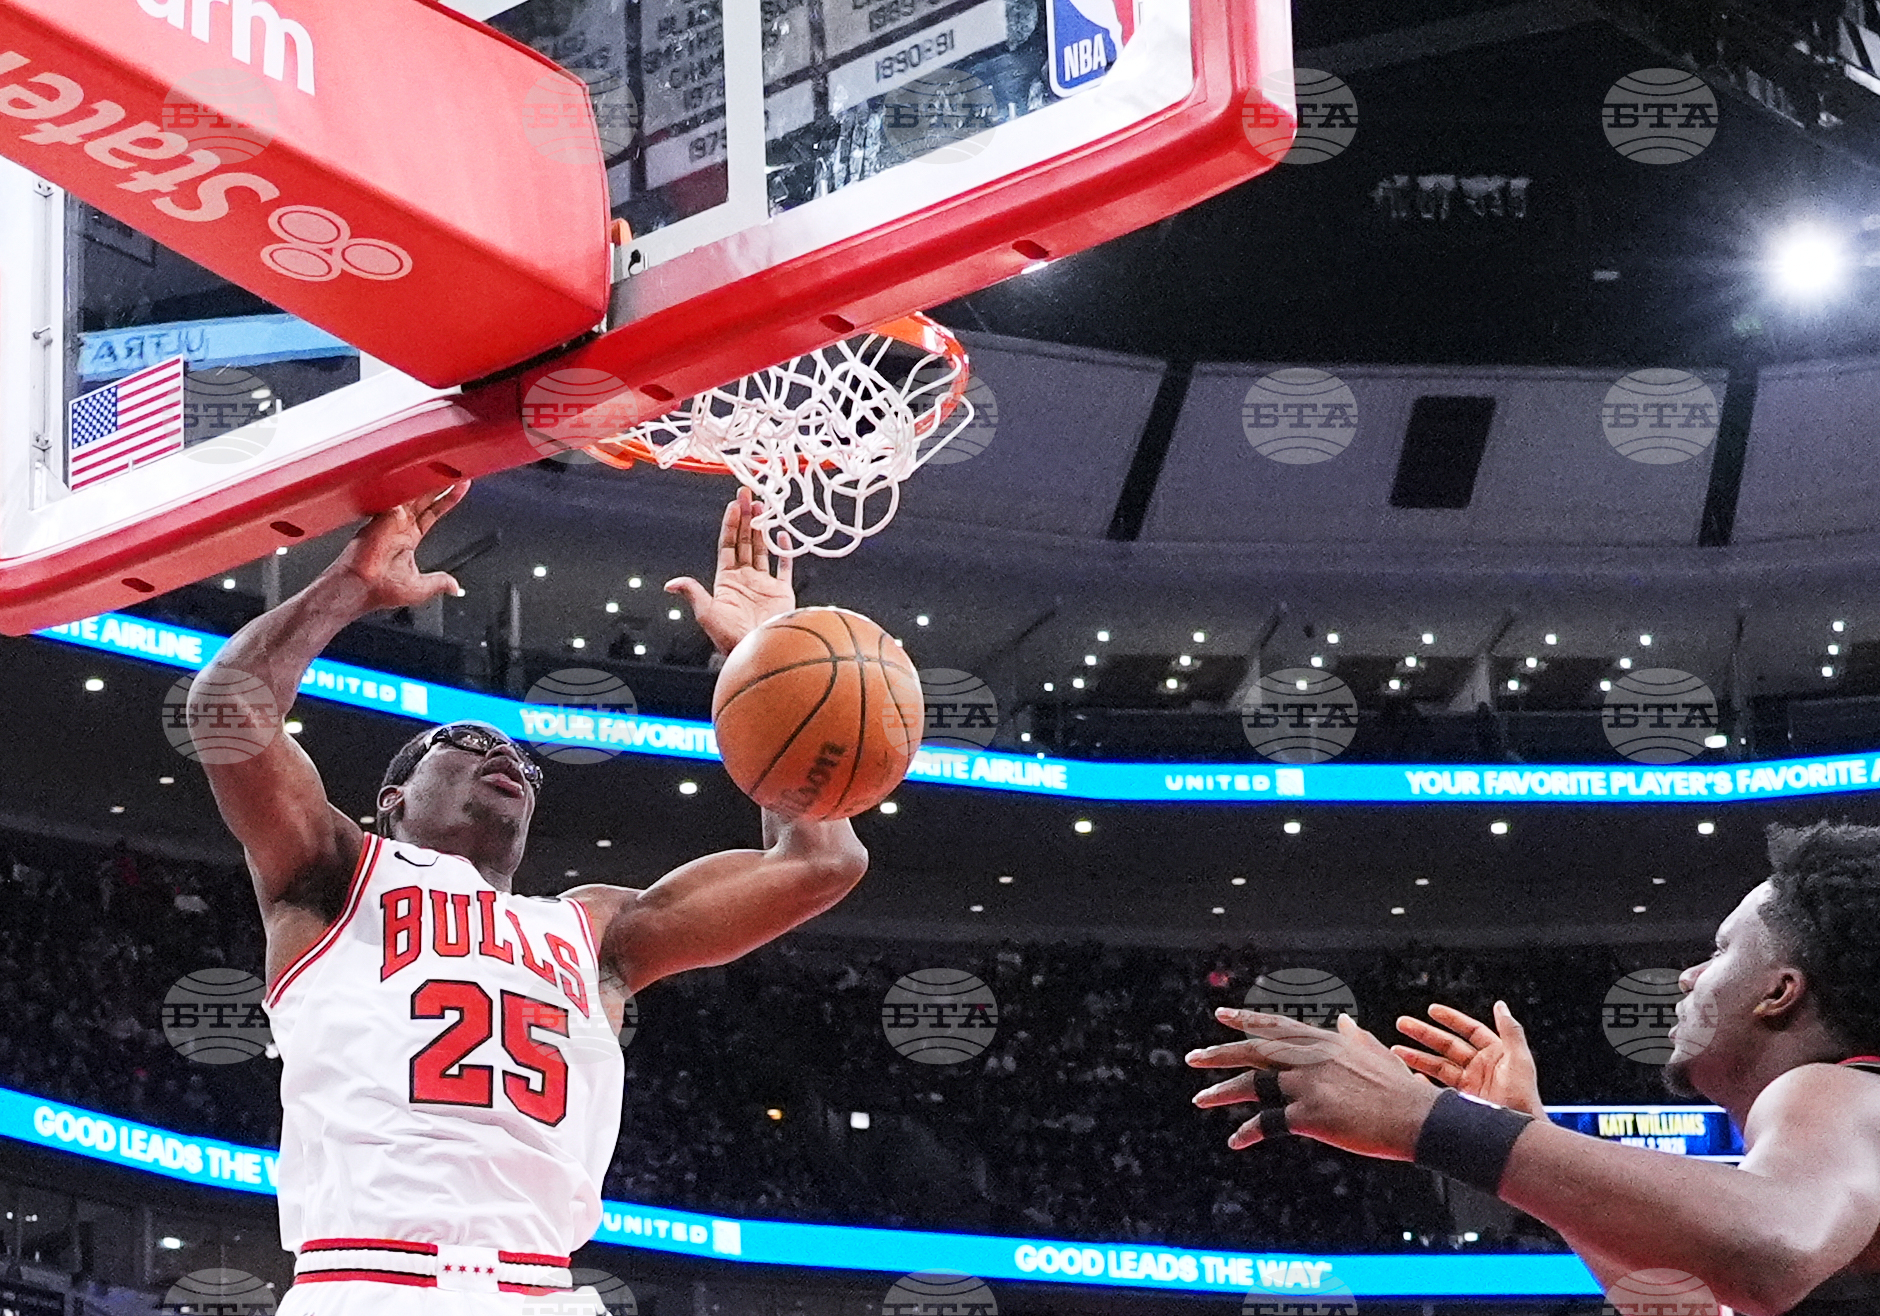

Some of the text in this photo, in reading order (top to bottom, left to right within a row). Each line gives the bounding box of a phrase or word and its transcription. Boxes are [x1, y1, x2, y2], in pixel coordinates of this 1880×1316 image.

[1063, 33, 1108, 82] NBA
[0, 71, 281, 222] State
[100, 618, 201, 664] AIRLINE
[302, 668, 396, 703] UNITED
[520, 709, 595, 741] YOUR
[598, 717, 720, 754] FAVORITE
[970, 757, 1067, 790] AIRLINE
[1165, 774, 1270, 791] UNITED
[1404, 771, 1481, 795] YOUR
[1484, 771, 1607, 796] FAVORITE
[1610, 769, 1733, 796] PLAYER'S
[1737, 759, 1868, 794] FAVORITE
[380, 885, 590, 1019] BULLS
[409, 978, 570, 1128] 25
[34, 1106, 117, 1152] GOOD
[119, 1126, 203, 1174] LEADS
[205, 1147, 262, 1184] THE
[602, 1212, 708, 1244] UNITED
[1014, 1244, 1105, 1276] GOOD
[1107, 1250, 1199, 1282] LEADS
[1200, 1256, 1255, 1286] THE
